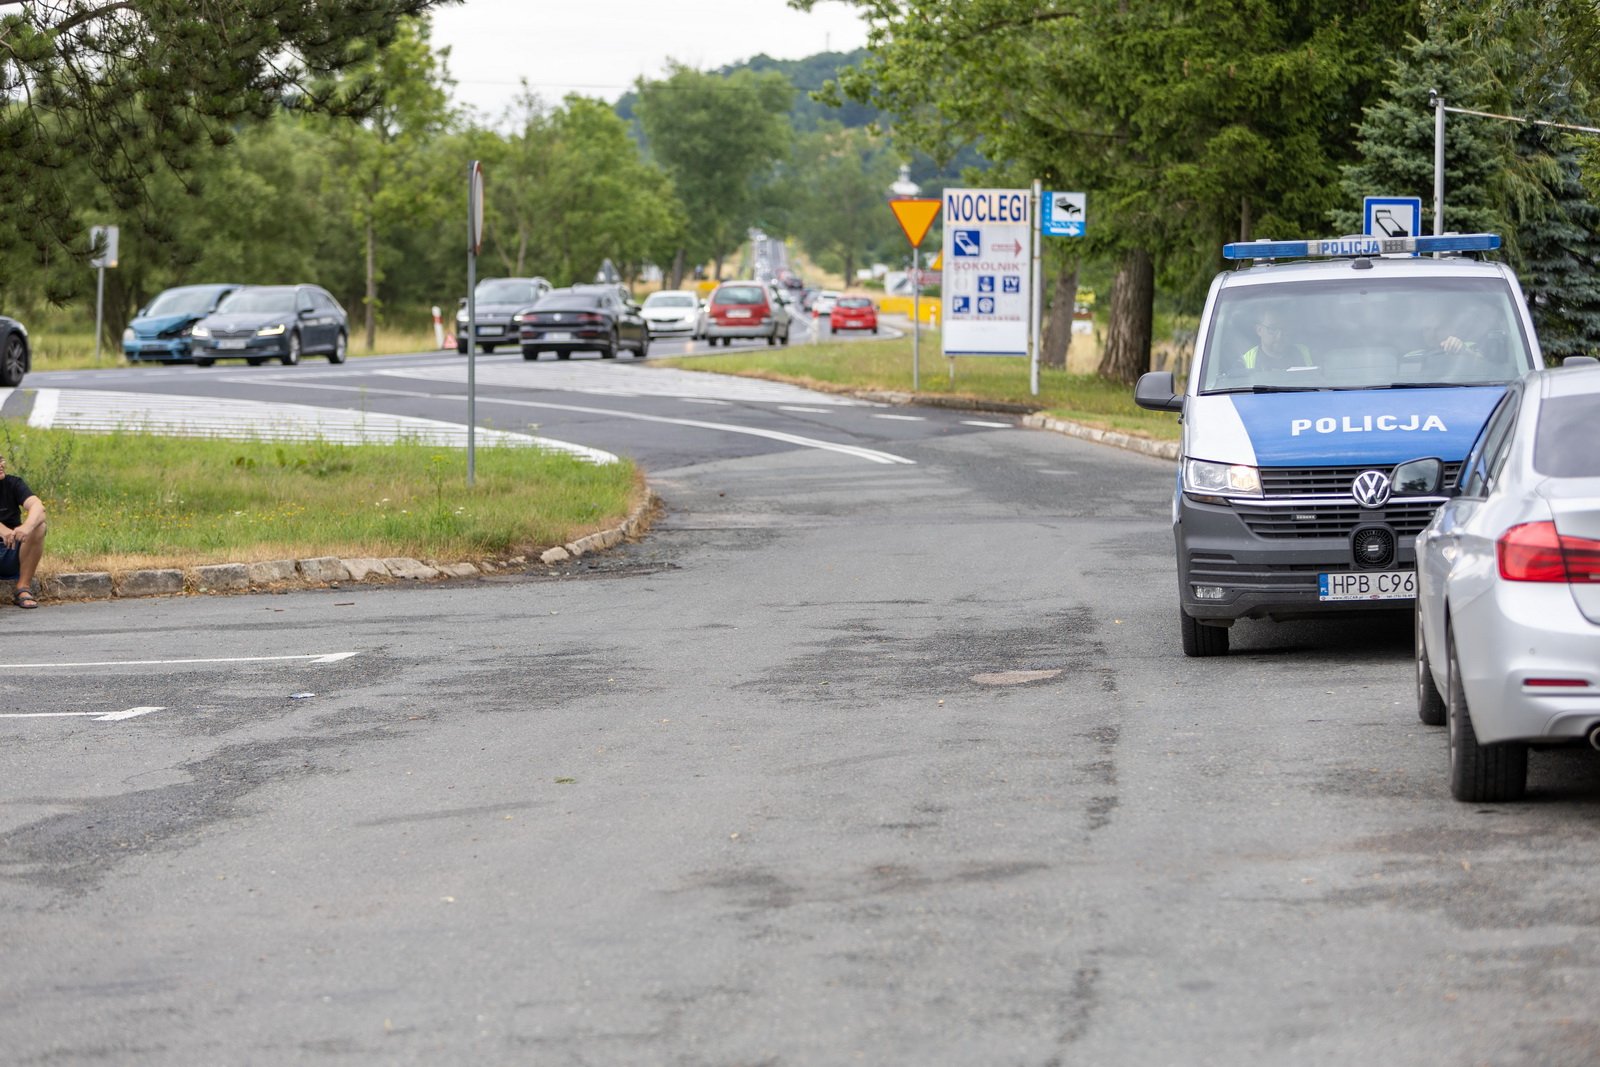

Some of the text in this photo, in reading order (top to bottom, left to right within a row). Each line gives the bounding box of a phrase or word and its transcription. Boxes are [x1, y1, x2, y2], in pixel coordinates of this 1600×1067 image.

[948, 194, 1027, 222] NOCLEGI
[1321, 240, 1380, 255] POLICJA
[1291, 414, 1448, 437] POLICJA
[1333, 573, 1414, 594] HPB C96
